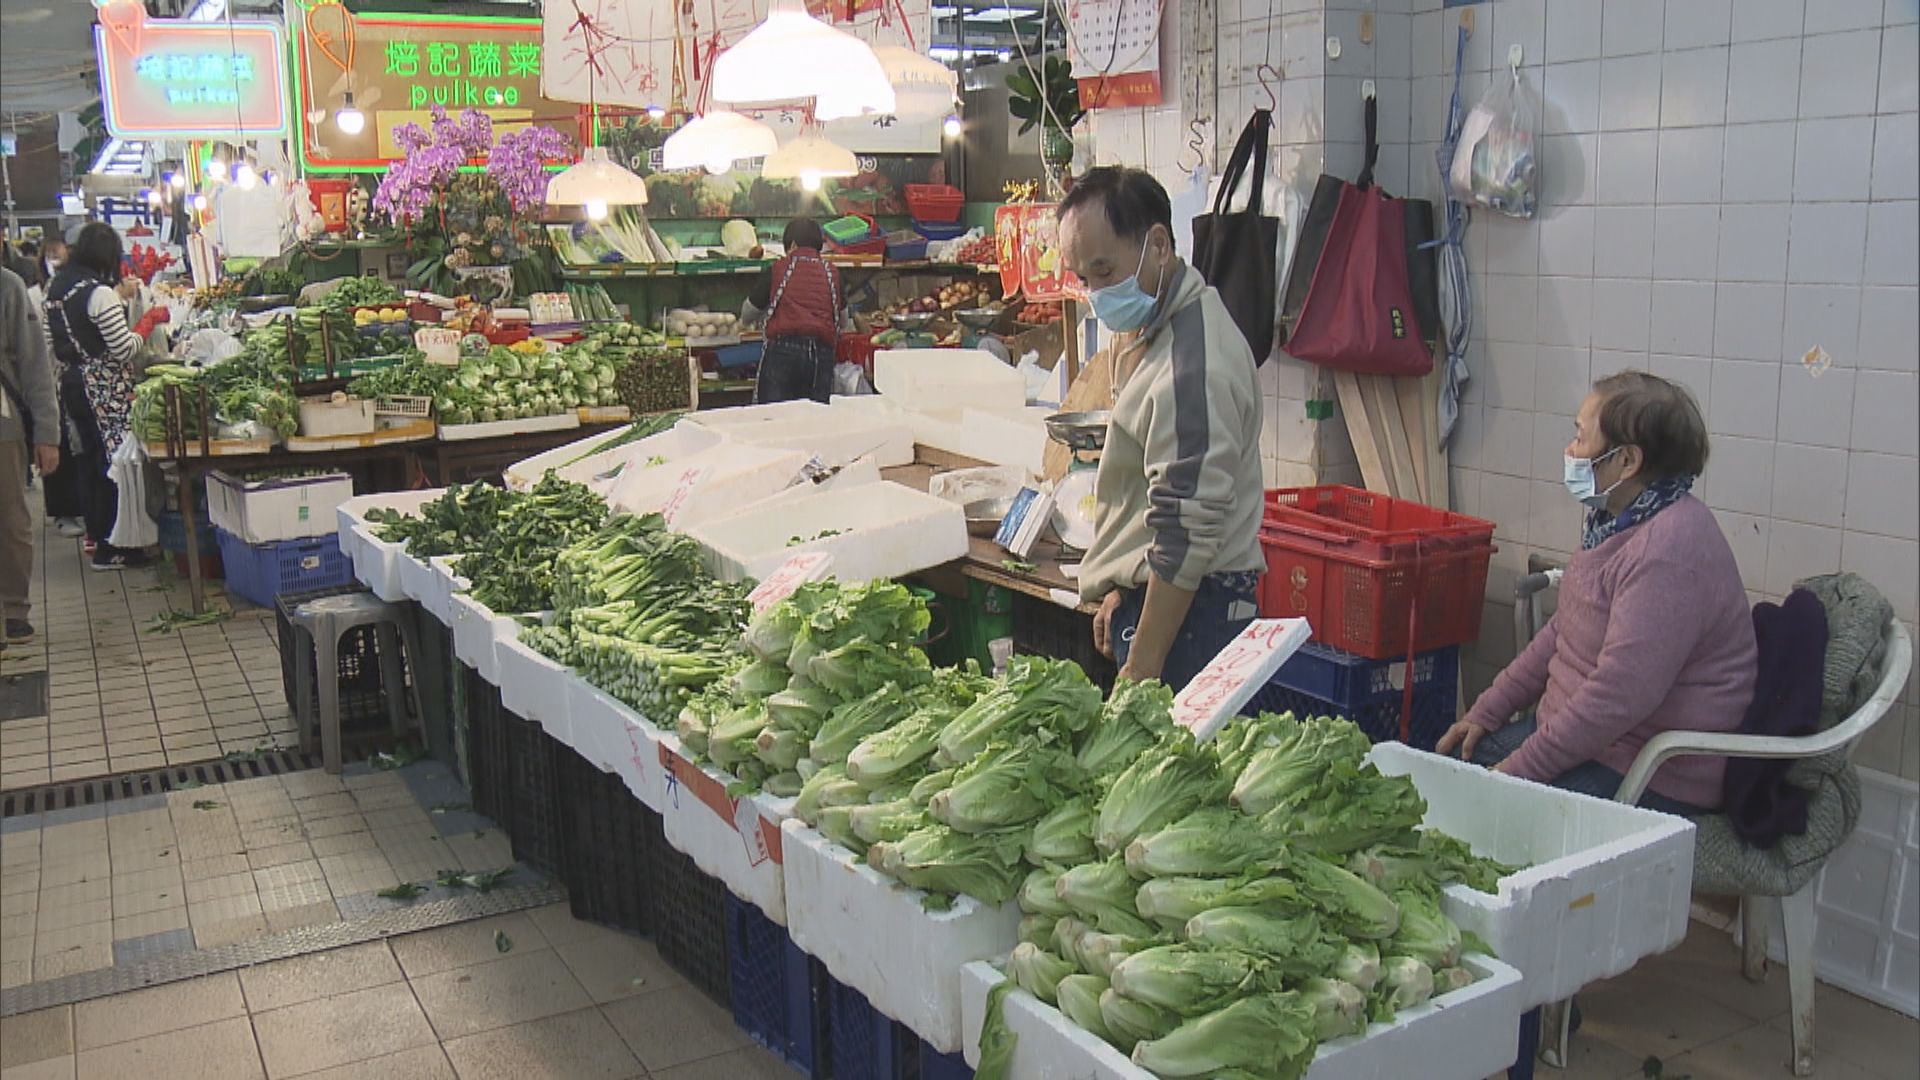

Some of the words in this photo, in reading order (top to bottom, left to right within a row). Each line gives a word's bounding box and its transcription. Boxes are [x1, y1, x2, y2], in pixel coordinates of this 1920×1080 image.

[384, 40, 542, 78] 培記蔬菜
[410, 79, 519, 110] pulkee
